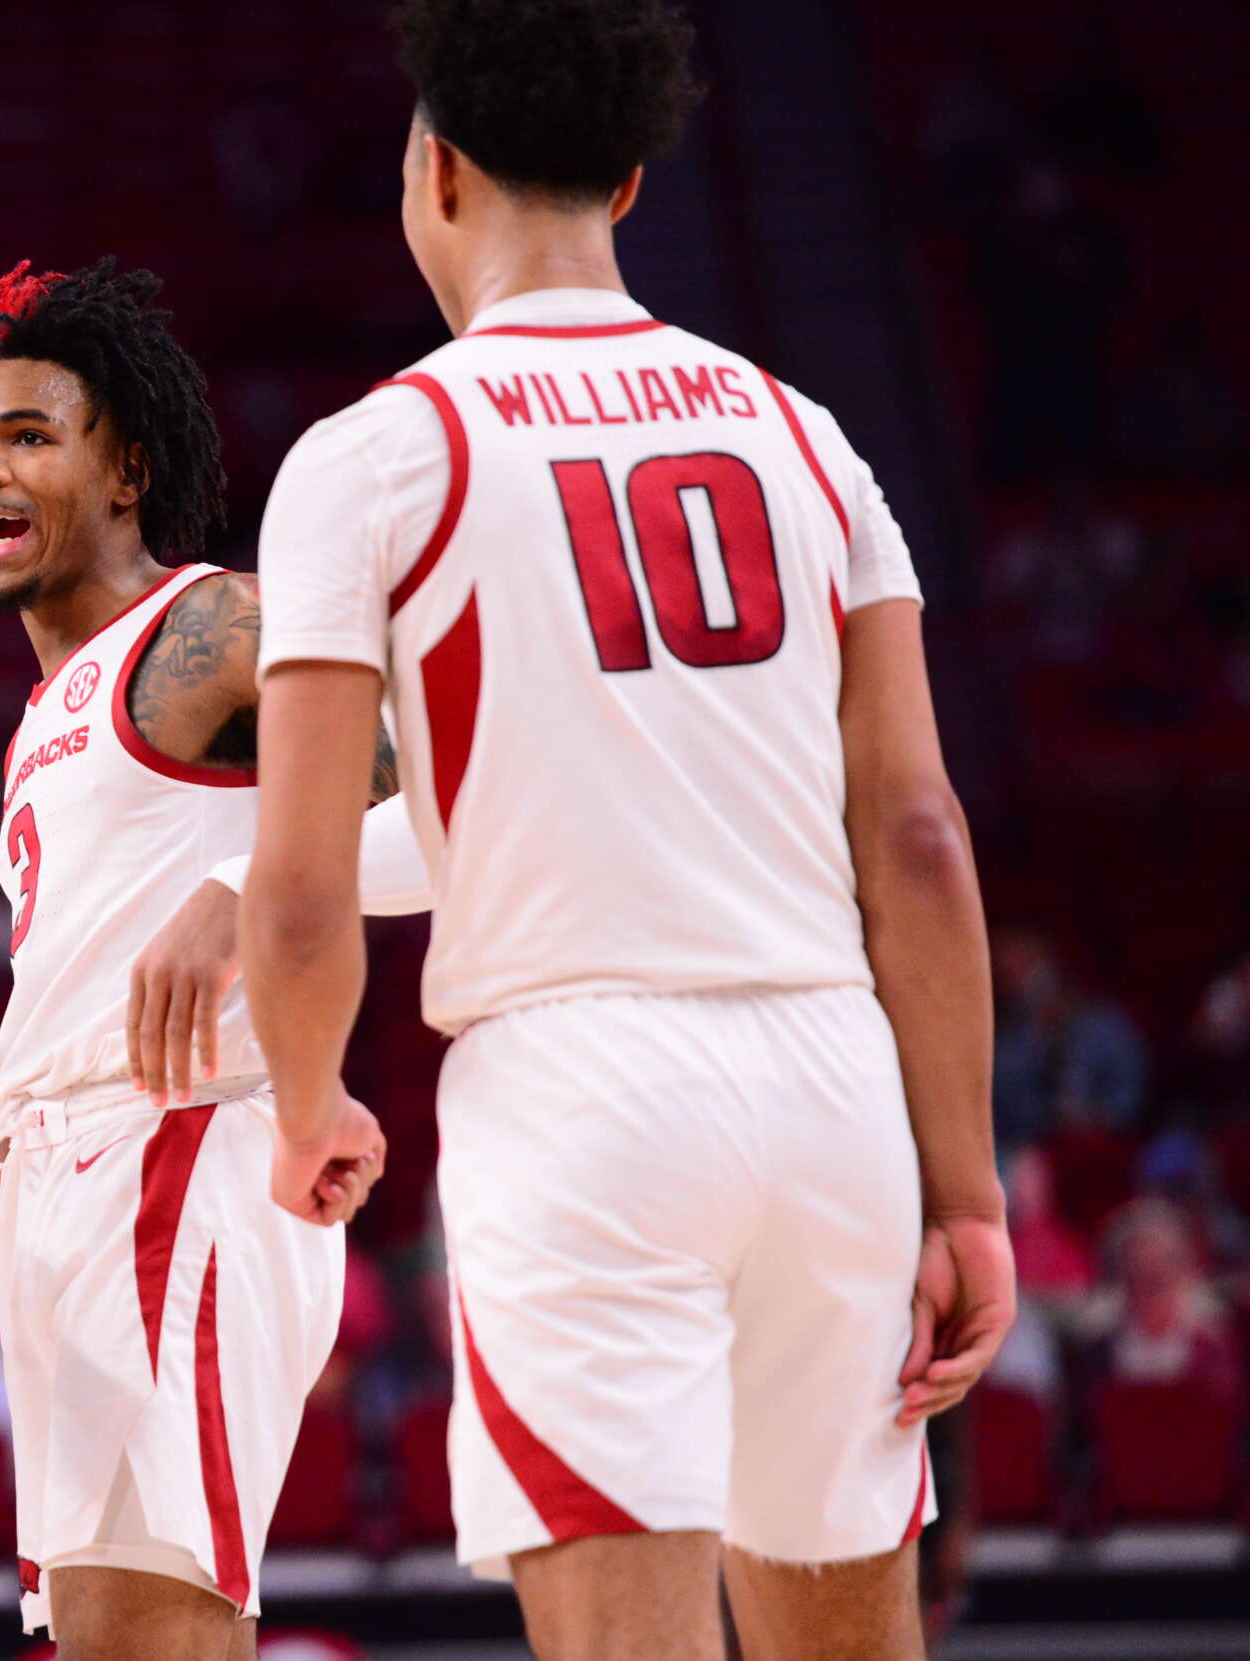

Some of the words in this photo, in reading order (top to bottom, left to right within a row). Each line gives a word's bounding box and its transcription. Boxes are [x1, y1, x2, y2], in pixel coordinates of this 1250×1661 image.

[476, 364, 758, 427] WILLIAMS
[549, 450, 786, 672] 10
[66, 663, 99, 709] SEC
[7, 802, 41, 959] 3
